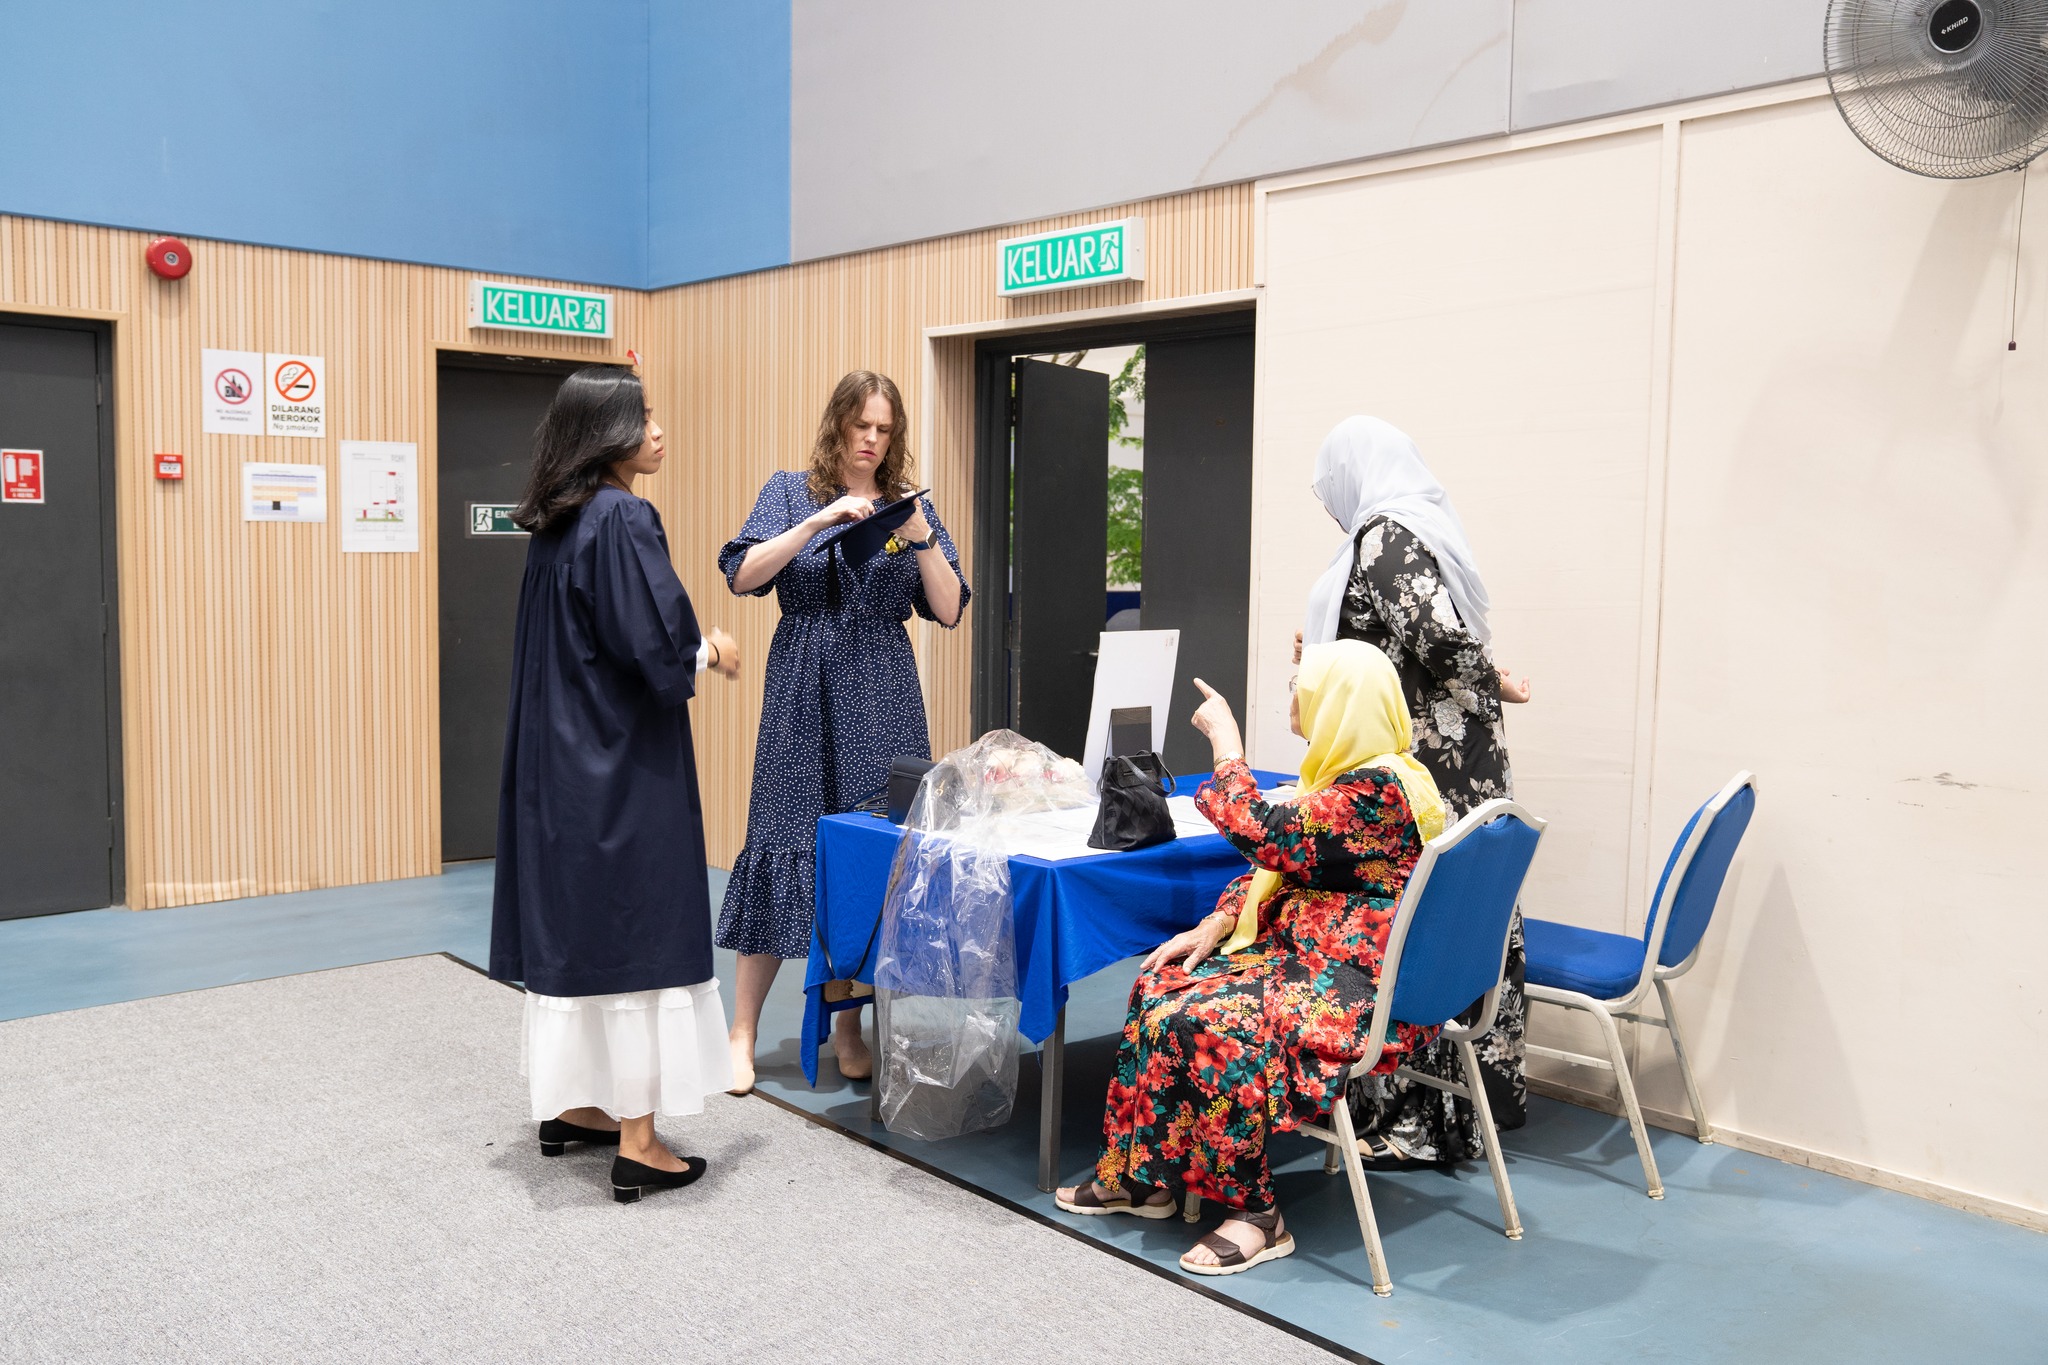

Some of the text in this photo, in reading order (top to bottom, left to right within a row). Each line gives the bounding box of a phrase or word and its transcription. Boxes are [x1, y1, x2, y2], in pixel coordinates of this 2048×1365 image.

[1007, 235, 1096, 286] KELUAR
[486, 289, 581, 329] KELUAR
[271, 404, 321, 414] DILARANG
[272, 414, 321, 423] MEROKOK
[286, 424, 319, 432] smoking
